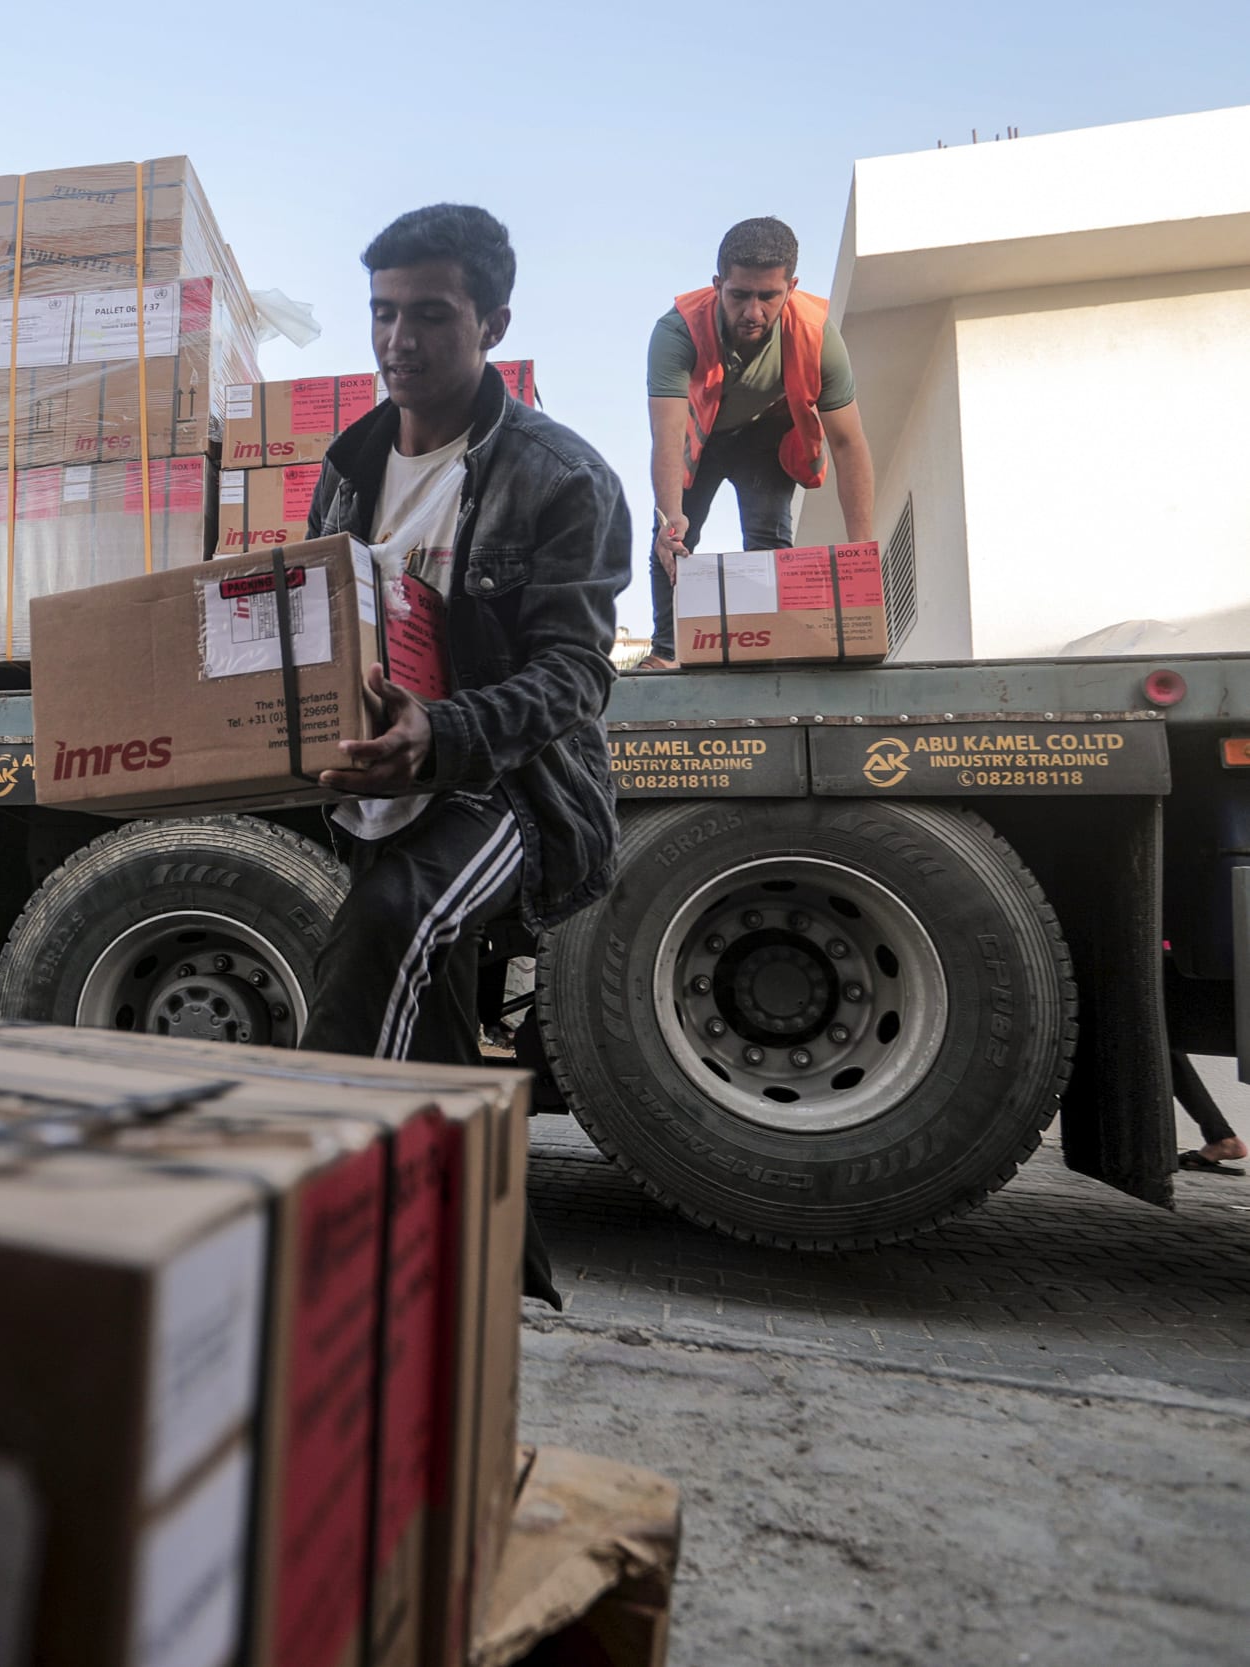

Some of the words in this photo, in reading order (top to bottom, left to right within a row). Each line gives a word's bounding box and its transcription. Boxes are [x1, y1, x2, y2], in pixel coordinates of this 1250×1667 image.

[95, 306, 124, 315] PALLET
[150, 303, 160, 311] 37
[340, 380, 358, 388] BOX
[226, 528, 287, 546] imres
[838, 549, 860, 558] BOX
[693, 628, 771, 650] imres
[255, 701, 274, 710] The
[277, 690, 338, 708] Nerlands
[227, 718, 244, 728] Tel.
[248, 713, 266, 725] +31
[303, 703, 338, 718] 296969
[277, 717, 340, 735] ww.imres.nl
[268, 730, 340, 749] imreimres.nl
[607, 742, 620, 756] U
[625, 741, 694, 756] KAMEL
[698, 739, 767, 755] CO.LTD
[914, 736, 957, 752] ABU
[963, 735, 1041, 751] KAMEL
[1046, 733, 1124, 750] CO.LTD
[53, 736, 172, 781] imres
[611, 757, 753, 772] DUSTRY&TRADING
[930, 753, 1109, 768] INDUSTRY&TRADING
[635, 774, 730, 788] 082818118
[976, 771, 1083, 786] 082818118
[654, 814, 743, 870] 13R22.5
[287, 905, 329, 953] CP
